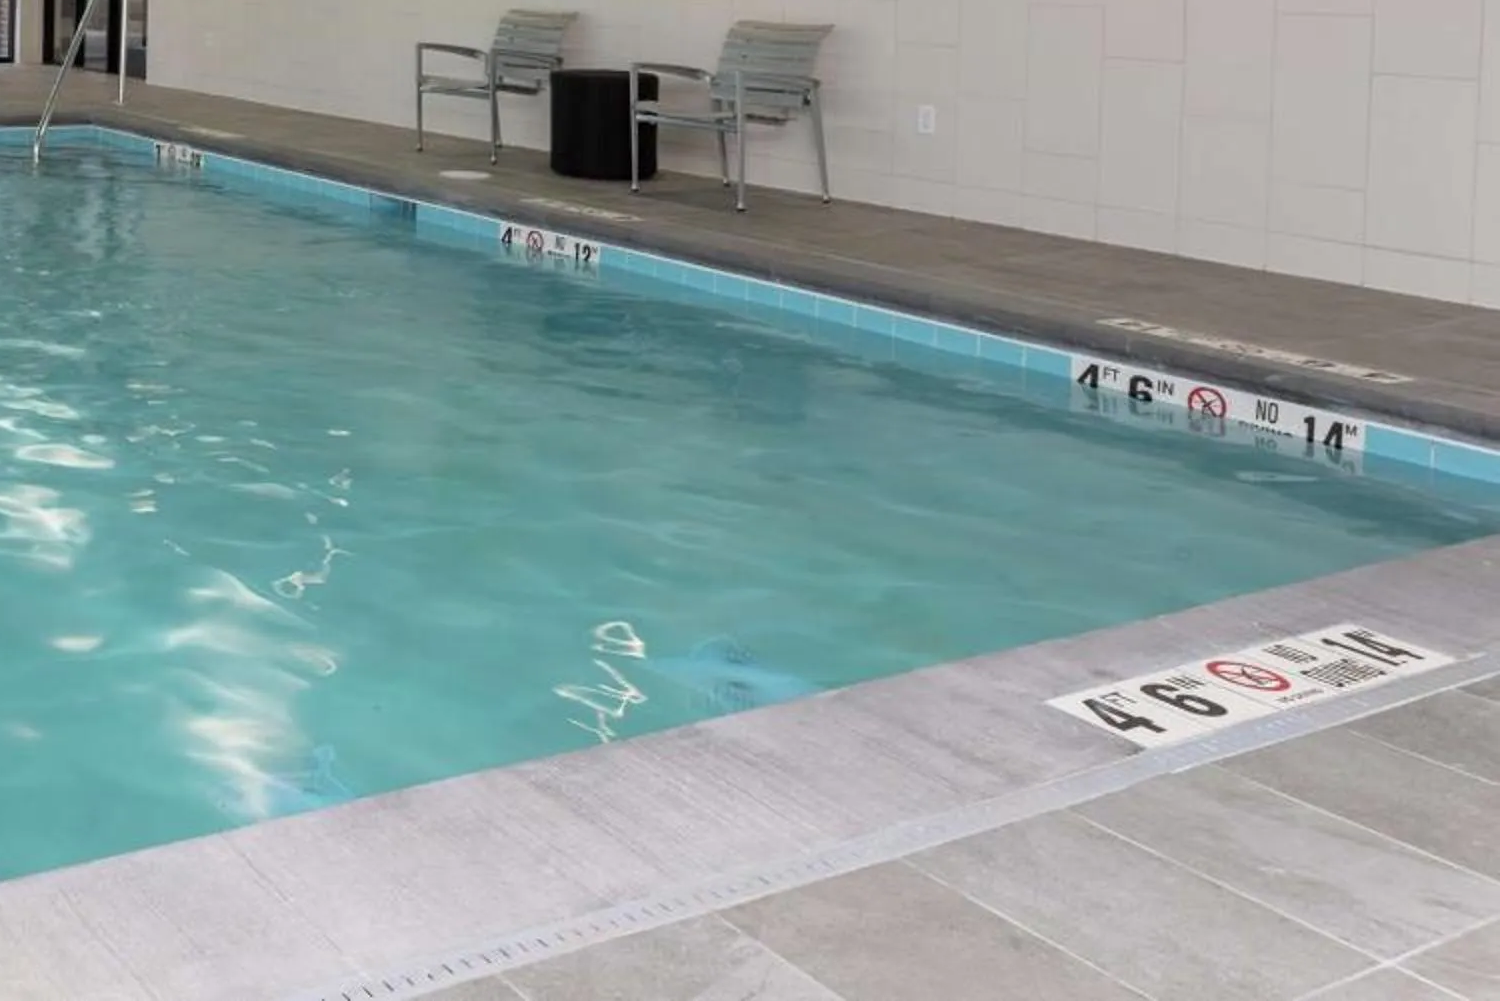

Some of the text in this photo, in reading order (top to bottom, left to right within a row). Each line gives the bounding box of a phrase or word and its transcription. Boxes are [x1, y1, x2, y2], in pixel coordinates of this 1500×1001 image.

[1157, 380, 1175, 396] IN
[1255, 399, 1279, 423] NO
[1082, 699, 1168, 733] 4
[1140, 683, 1228, 717] 6
